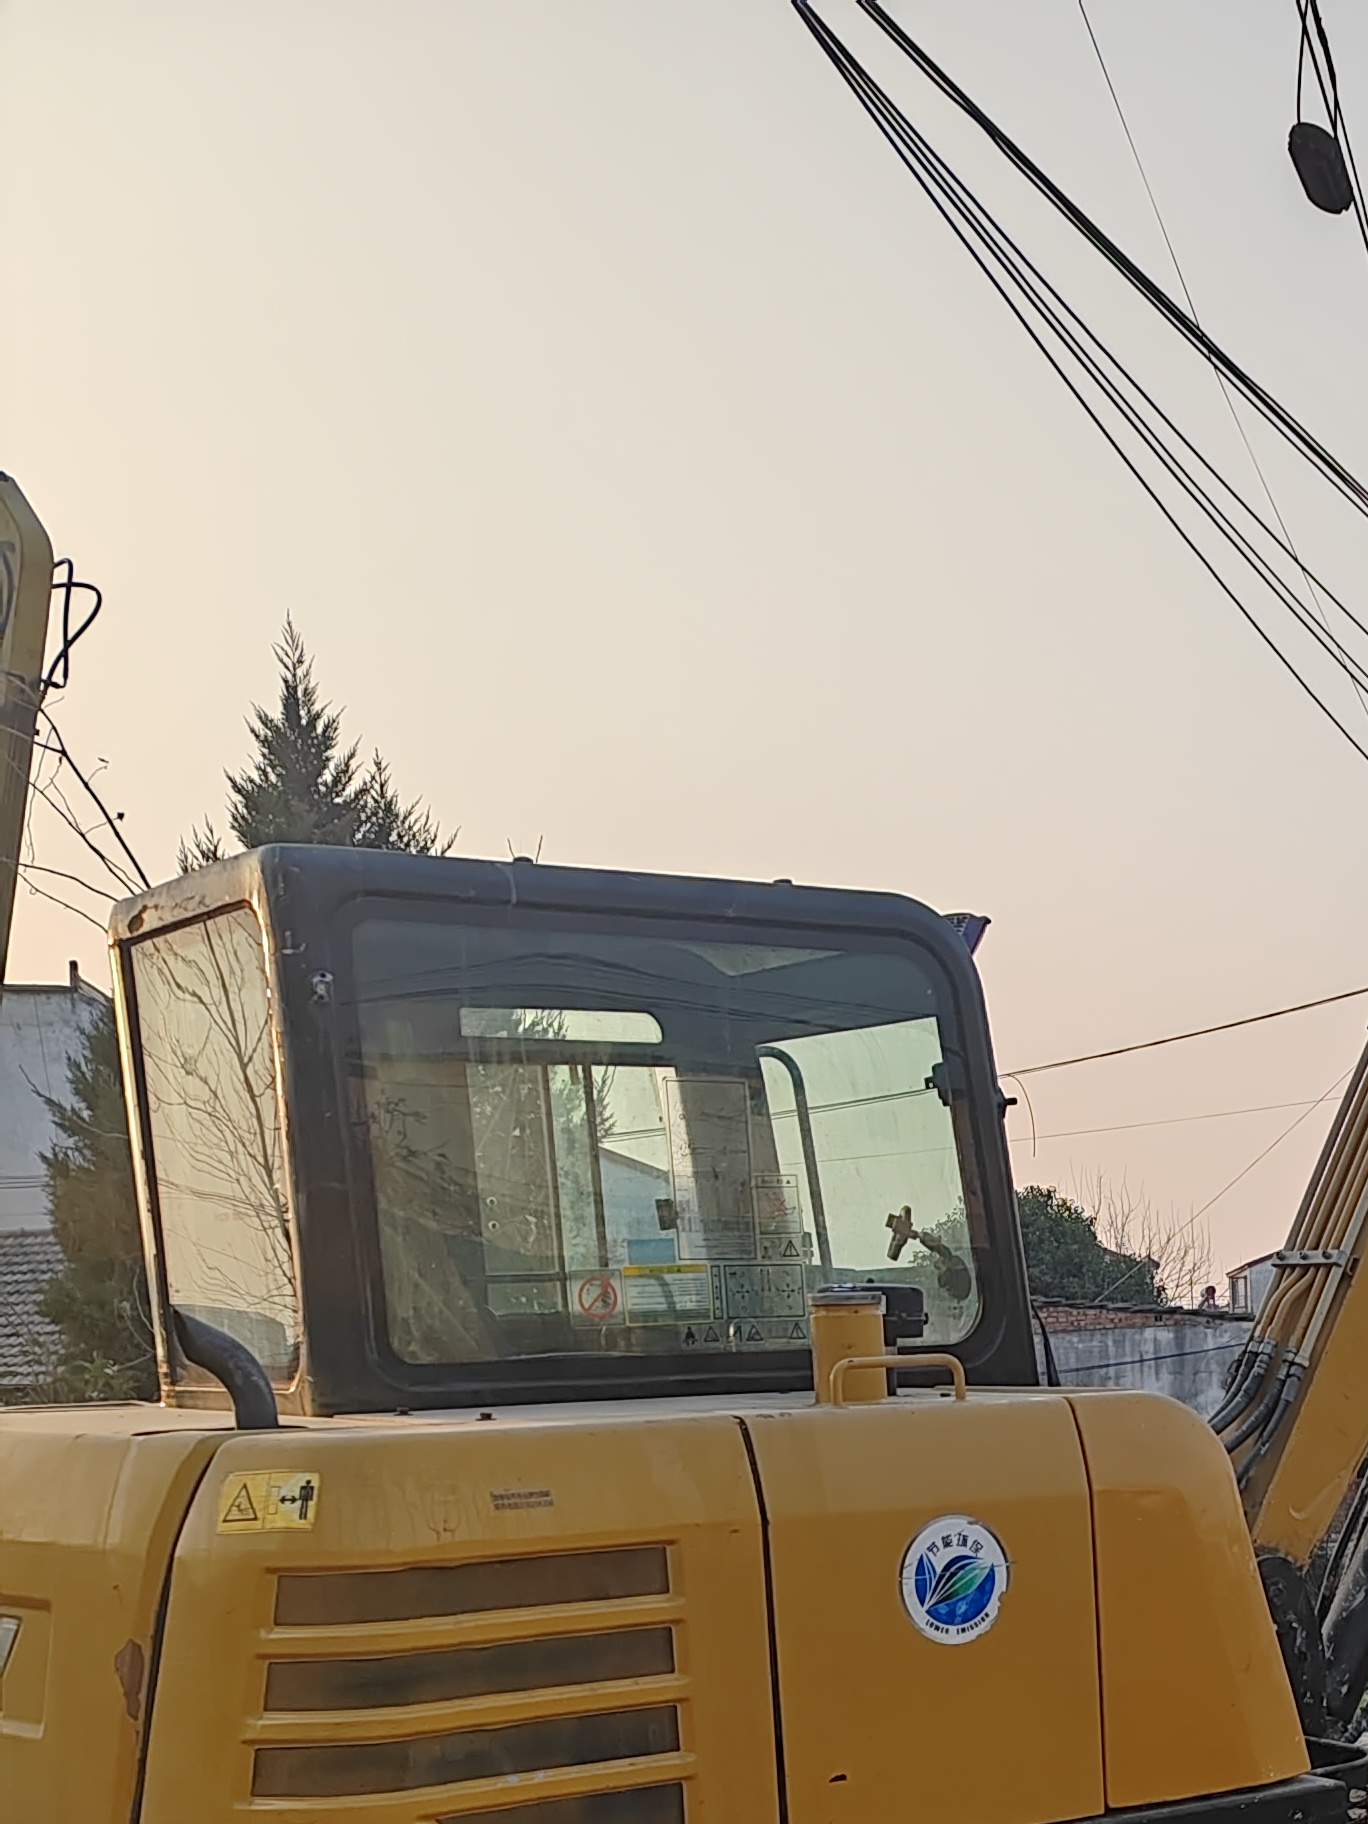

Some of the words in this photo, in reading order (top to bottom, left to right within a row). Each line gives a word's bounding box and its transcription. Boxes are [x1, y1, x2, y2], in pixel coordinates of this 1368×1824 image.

[926, 1532, 984, 1557] 节能环保
[956, 1612, 990, 1635] EMISSION
